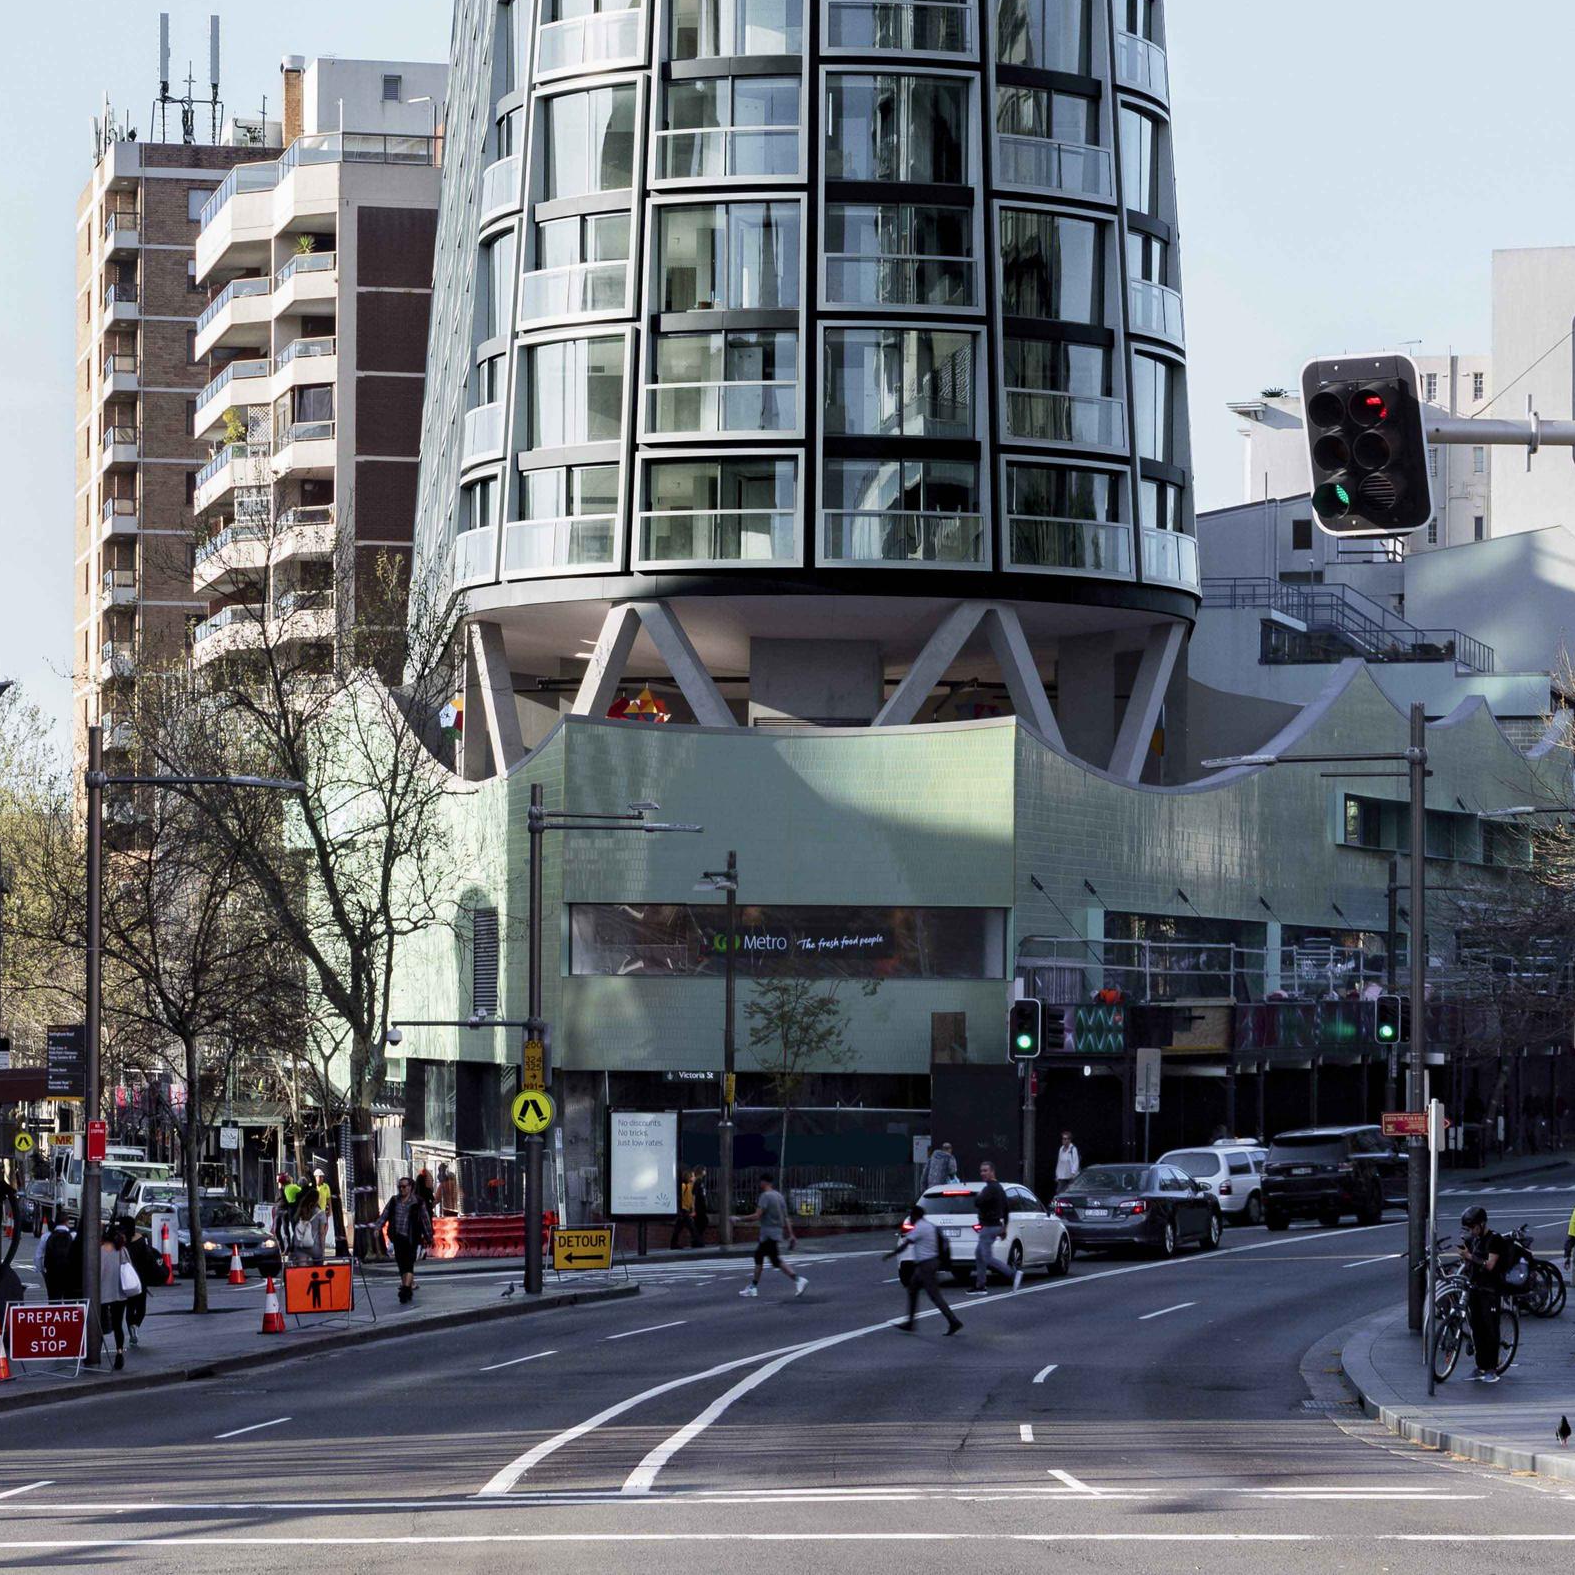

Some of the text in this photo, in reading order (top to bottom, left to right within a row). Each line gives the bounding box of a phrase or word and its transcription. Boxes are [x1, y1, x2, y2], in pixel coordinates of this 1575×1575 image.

[743, 933, 883, 952] Metro The fresh food people
[525, 1041, 542, 1049] 200
[678, 1071, 714, 1079] Victoria St
[55, 1135, 73, 1145] MR
[617, 1139, 631, 1147] Just
[631, 1139, 644, 1147] low
[558, 1235, 606, 1248] DETOUR
[17, 1310, 79, 1324] PREPARE
[40, 1326, 56, 1337] TO
[30, 1340, 67, 1352] STOP
